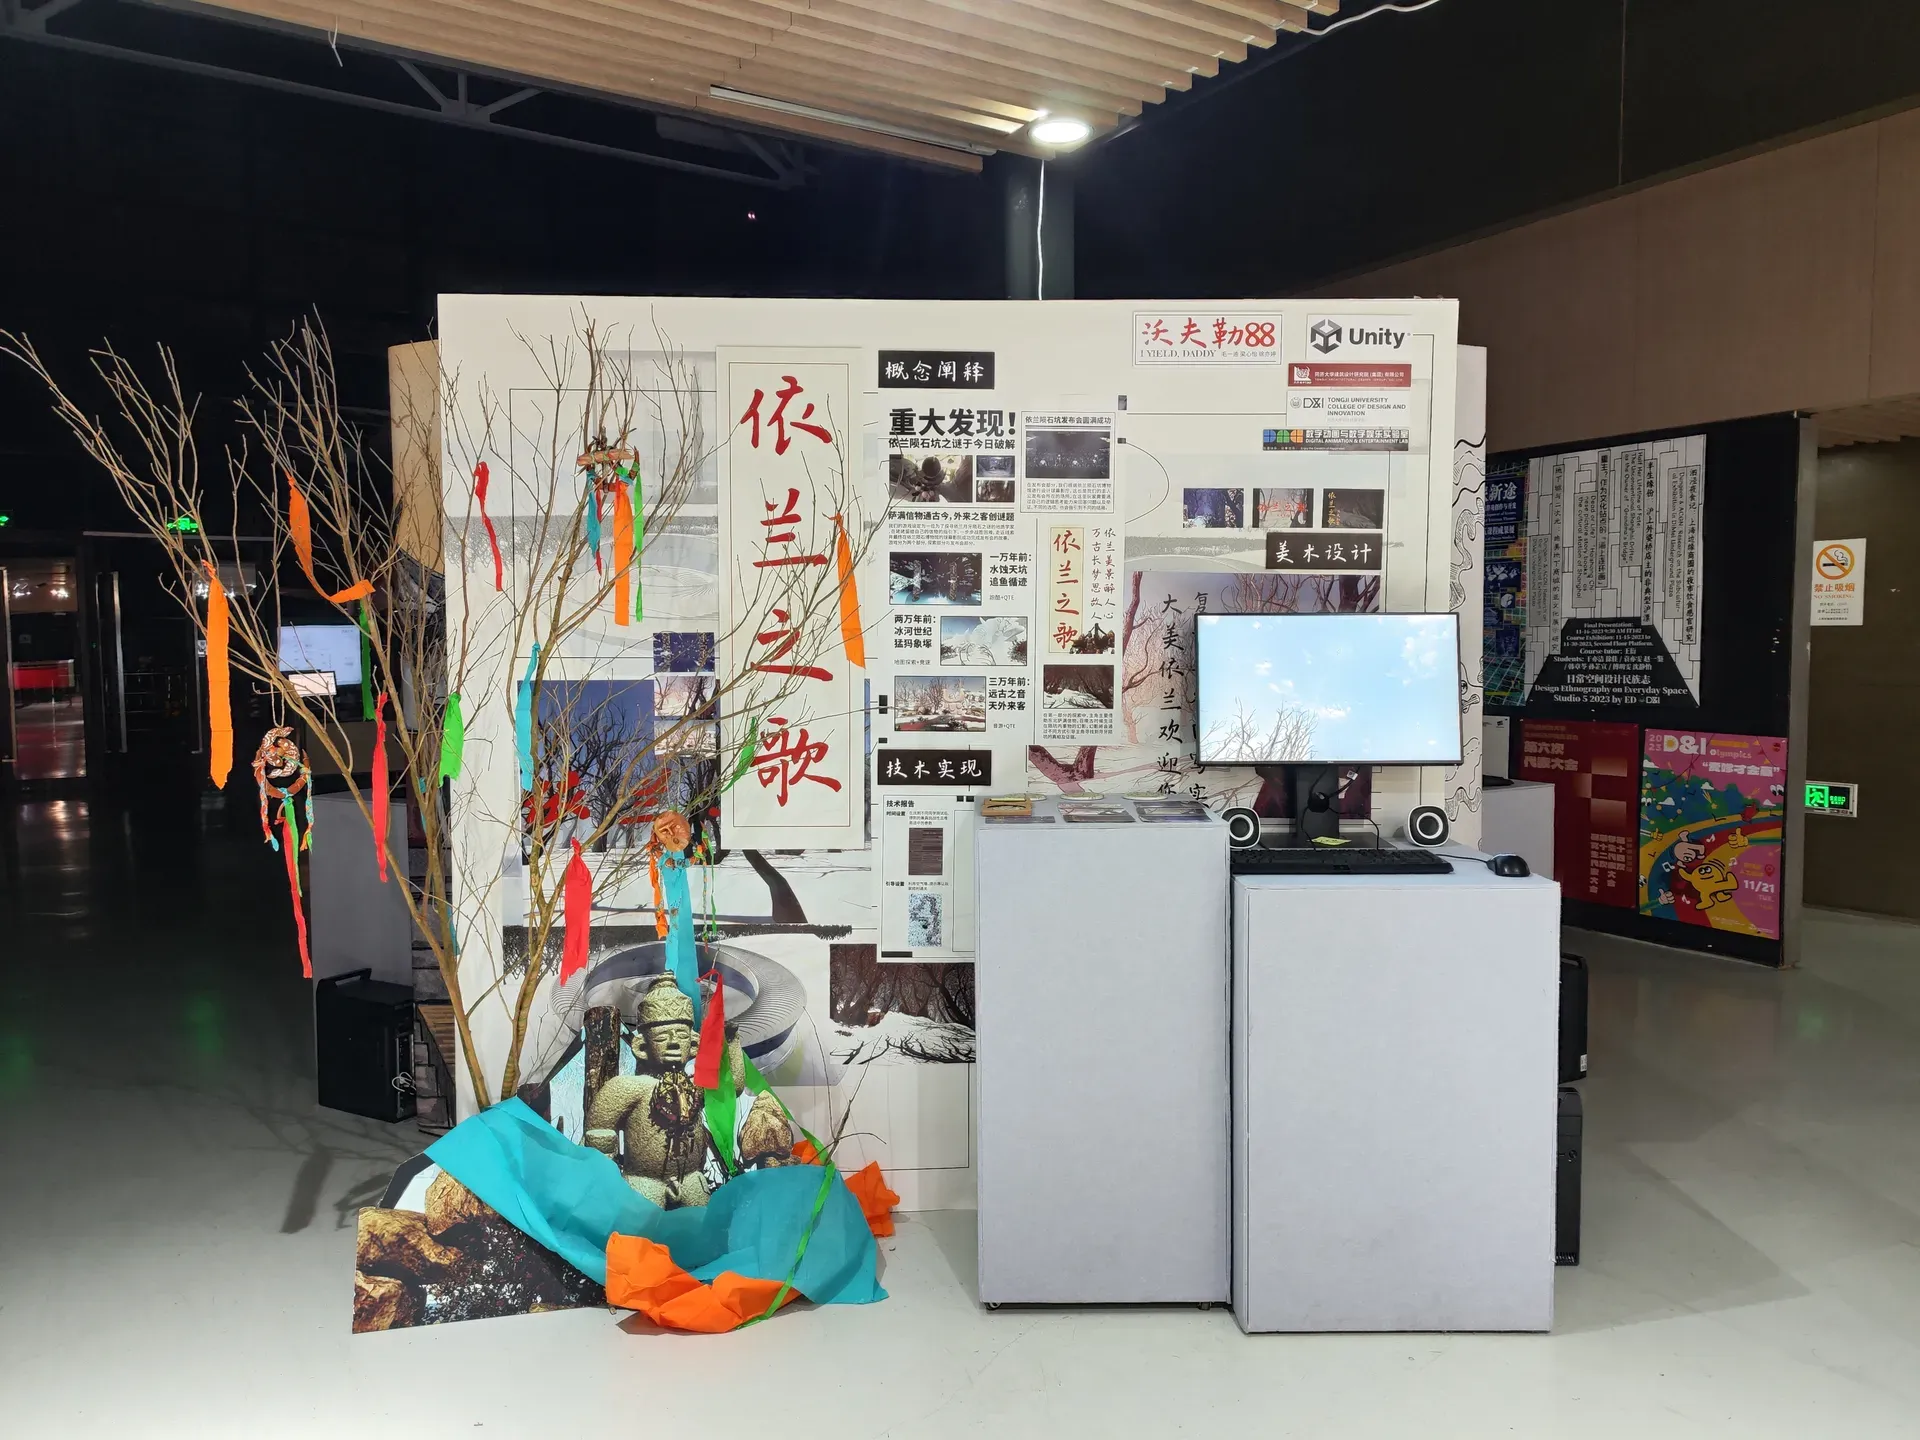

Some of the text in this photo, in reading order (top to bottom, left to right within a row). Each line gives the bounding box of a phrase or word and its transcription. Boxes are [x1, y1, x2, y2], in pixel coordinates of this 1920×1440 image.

[1142, 317, 1275, 349] 沃夫勒88
[1349, 328, 1405, 349] Unity
[885, 361, 986, 382] 概念阐释
[889, 408, 1016, 437] 重大发现！
[1025, 416, 1111, 424] 依兰陨石坑发布会圆满成功
[888, 438, 1015, 450] 依兰陨石坑之谜于今日破解
[888, 511, 1014, 521] 萨满信物通古今，外来之客创谜题
[990, 553, 1032, 561] 一万年前：
[1275, 541, 1372, 563] 美术设计
[989, 565, 1028, 574] 水蚀天坑
[1090, 528, 1102, 620] 万古长梦思故人
[1103, 528, 1116, 619] 依兰美景醉人心
[989, 577, 1027, 586] 追鱼循迹
[741, 375, 842, 808] 依兰之歌
[1053, 530, 1080, 649] 依兰之歌
[1814, 583, 1855, 592] 禁止吸烟
[894, 614, 936, 623] 两万年前：
[894, 627, 932, 636] 冰河世纪
[988, 677, 1030, 686] 三万年前：
[1567, 674, 1651, 684] 日常空间设计民族志
[988, 689, 1026, 698] 远古之音
[1535, 684, 1560, 693] Design
[1561, 685, 1611, 694] Ethnography
[1624, 686, 1661, 695] Everyday
[1662, 687, 1688, 695] Space
[1553, 694, 1581, 702] Studio
[1589, 695, 1611, 703] 2023
[1611, 695, 1623, 704] by
[988, 701, 1026, 711] 天外来客
[1649, 734, 1663, 743] 20
[1524, 740, 1565, 755] 第六次
[1649, 743, 1663, 751] 23
[1663, 735, 1707, 755] D&I
[1709, 748, 1752, 760] Olympics
[886, 758, 982, 779] 技术实现
[1524, 755, 1579, 771] 代表大会
[886, 800, 915, 808] 技术报告
[1743, 880, 1775, 893] 11/21
